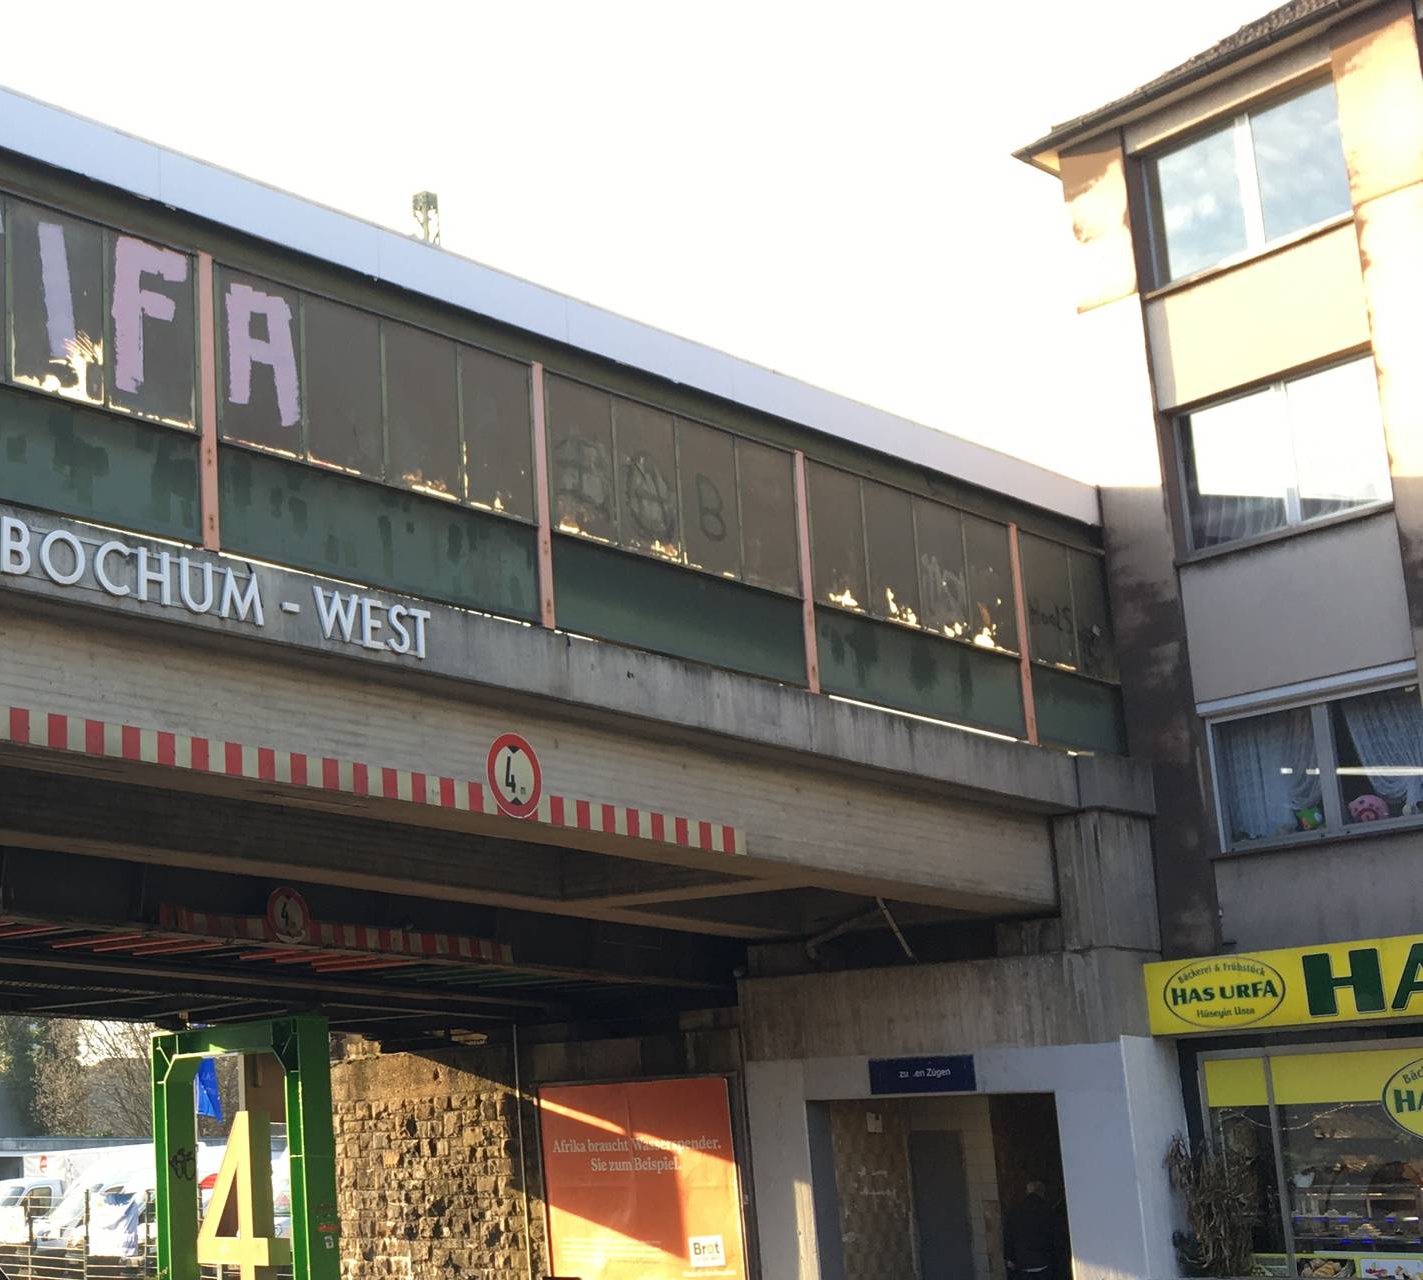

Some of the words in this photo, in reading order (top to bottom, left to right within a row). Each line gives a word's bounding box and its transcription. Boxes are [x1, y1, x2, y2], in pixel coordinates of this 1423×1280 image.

[0, 516, 264, 626] BOCHUM
[312, 585, 431, 659] WEST
[505, 756, 516, 793] 4
[1223, 962, 1266, 977] Frühstück
[1171, 987, 1216, 1007] HAS
[1219, 979, 1279, 999] URFA
[913, 1069, 925, 1078] en
[926, 1067, 951, 1079] Zügen
[1393, 1089, 1423, 1113] H
[553, 1139, 587, 1153] Afrika
[588, 1138, 628, 1152] braucht
[590, 1157, 608, 1172] Sie
[609, 1161, 633, 1172] zum
[633, 1156, 682, 1174] Beispiel.
[196, 1110, 271, 1280] 4
[693, 1241, 720, 1256] Brot
